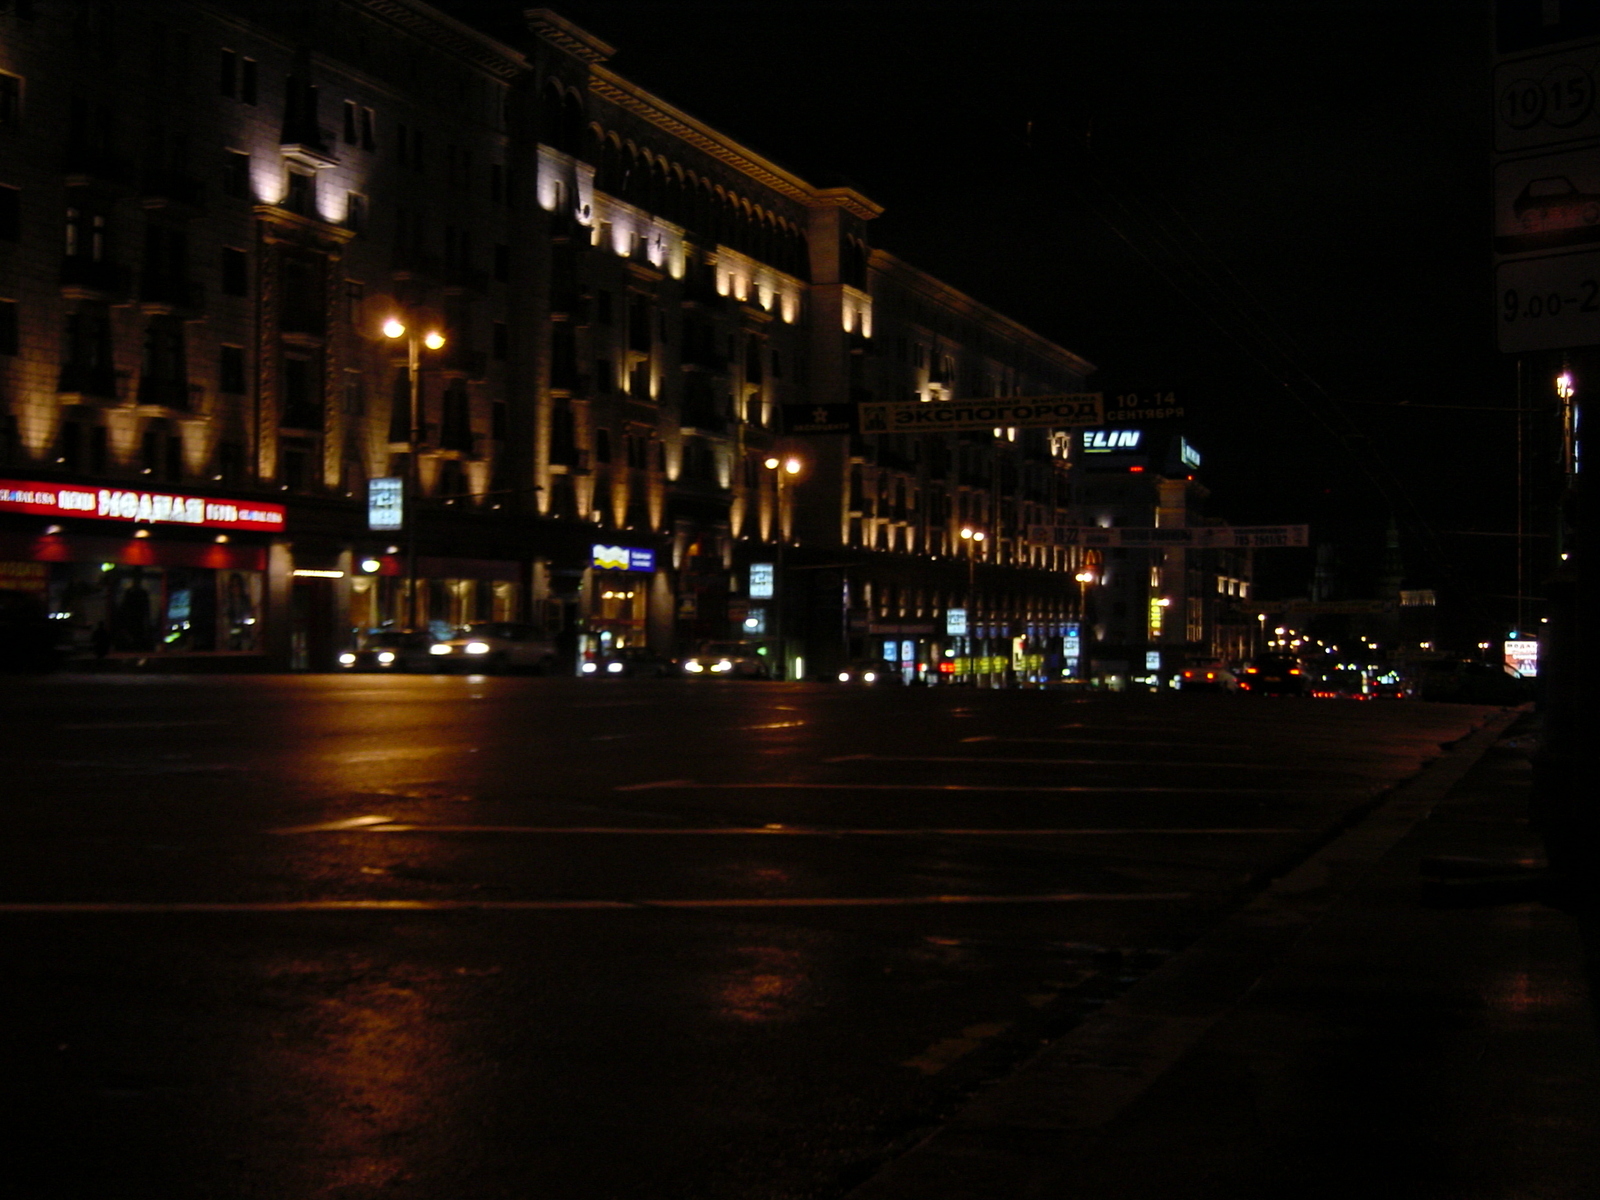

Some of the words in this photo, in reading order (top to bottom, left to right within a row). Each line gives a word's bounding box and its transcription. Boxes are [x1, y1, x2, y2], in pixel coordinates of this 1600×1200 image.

[1509, 87, 1537, 116] 10
[1553, 77, 1585, 111] 15
[1116, 393, 1138, 408] 10
[1154, 391, 1176, 406] 14
[894, 402, 1099, 425] ЭКСПОГОРОД
[1107, 407, 1185, 421] СЕНТЯБРЯ
